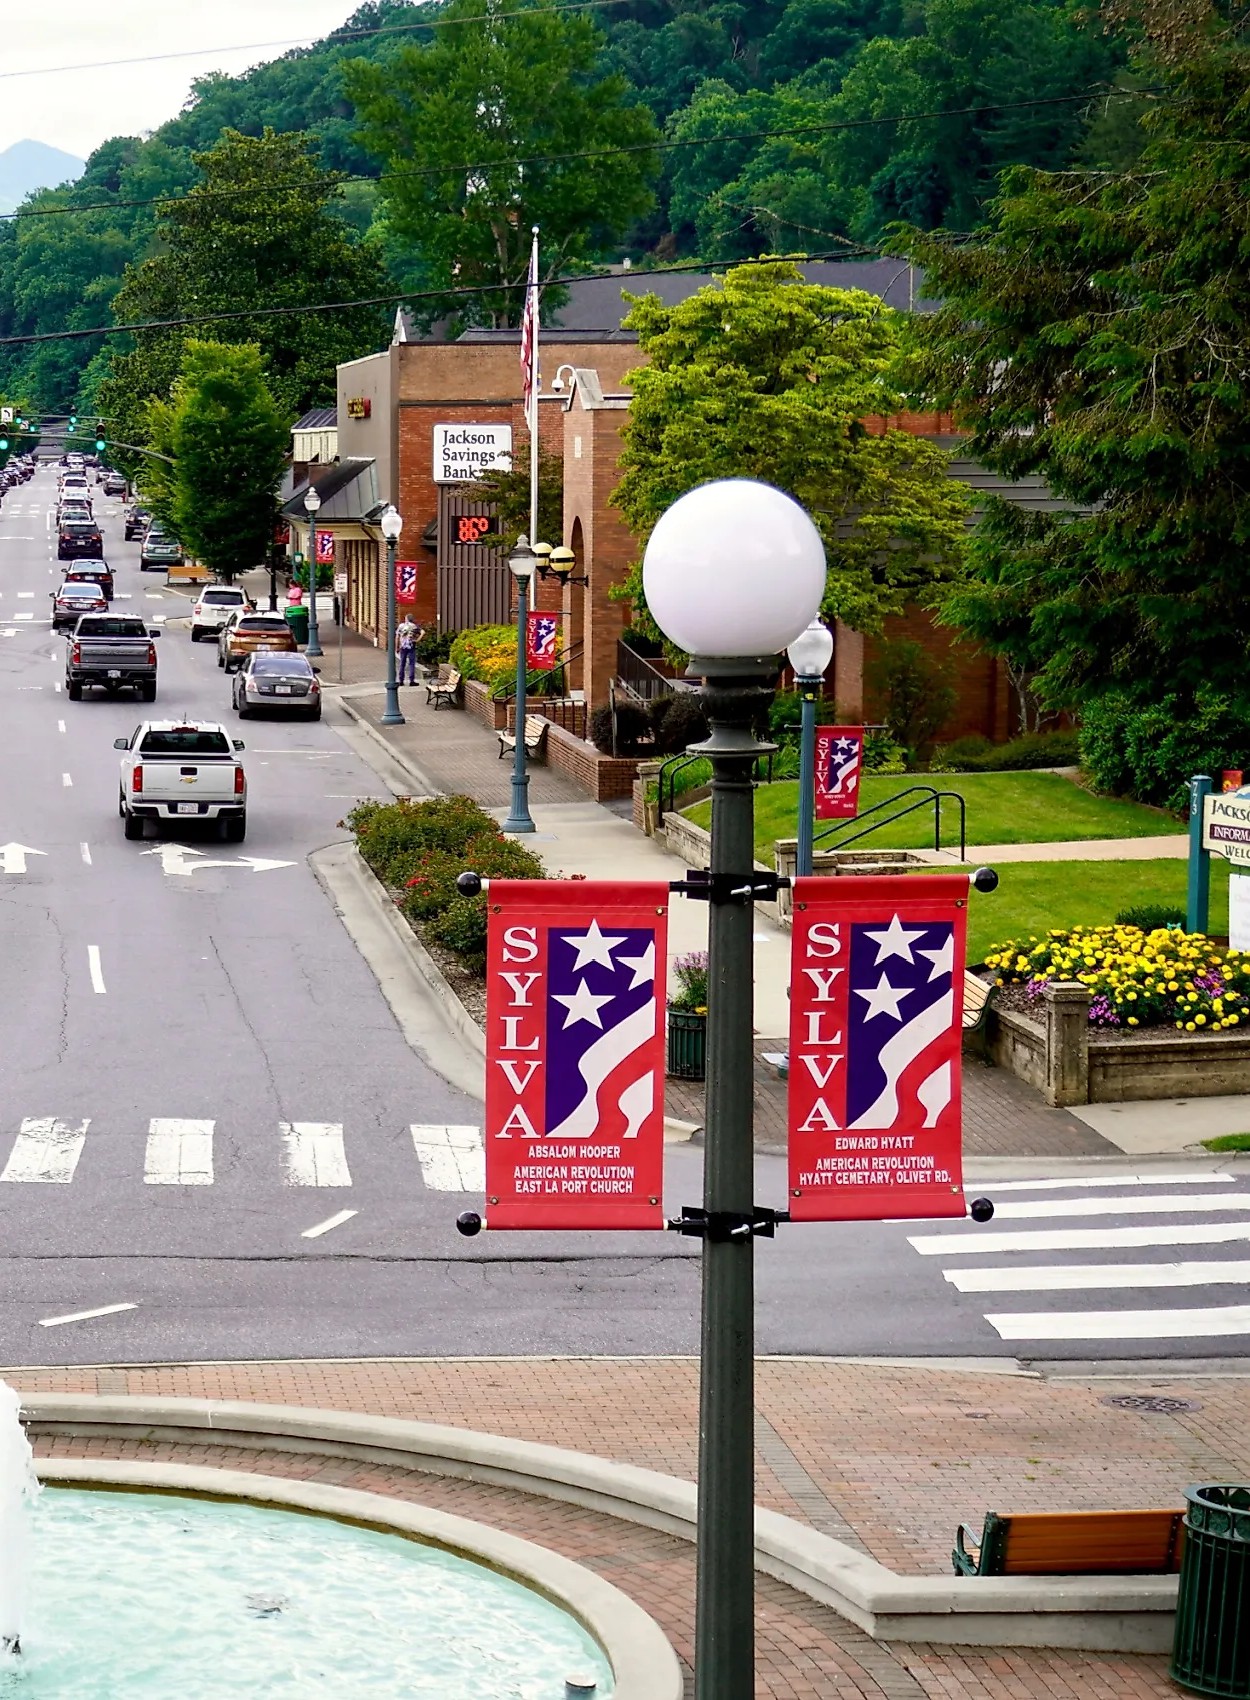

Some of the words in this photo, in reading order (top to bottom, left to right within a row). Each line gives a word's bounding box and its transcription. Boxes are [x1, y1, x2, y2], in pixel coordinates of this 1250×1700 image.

[442, 430, 495, 447] Jackson
[442, 447, 496, 466] Savings
[443, 464, 478, 478] Bank
[528, 618, 537, 655] SYLVA
[816, 737, 830, 794] SYLVA
[1213, 826, 1250, 842] INFORM
[494, 926, 543, 1139] SYLVA
[797, 922, 845, 1132] SYLVA
[835, 1137, 878, 1150] EDWARD
[881, 1136, 915, 1149] HYATT
[528, 1145, 577, 1158] ABSALOM
[579, 1145, 621, 1158] HOOPER
[816, 1157, 869, 1171] AMERICAN
[872, 1156, 934, 1170] REVOLUTION
[513, 1166, 568, 1179] AMERICAN
[571, 1166, 635, 1179] REVOLUTION
[799, 1173, 833, 1186] HYATT
[835, 1171, 894, 1186] CEMETARY,
[896, 1170, 932, 1183] OLIVET
[934, 1170, 952, 1183] RD.
[515, 1180, 542, 1193] EAST
[545, 1180, 559, 1193] LA
[561, 1180, 588, 1193] PORT
[590, 1180, 633, 1193] CHURCH
